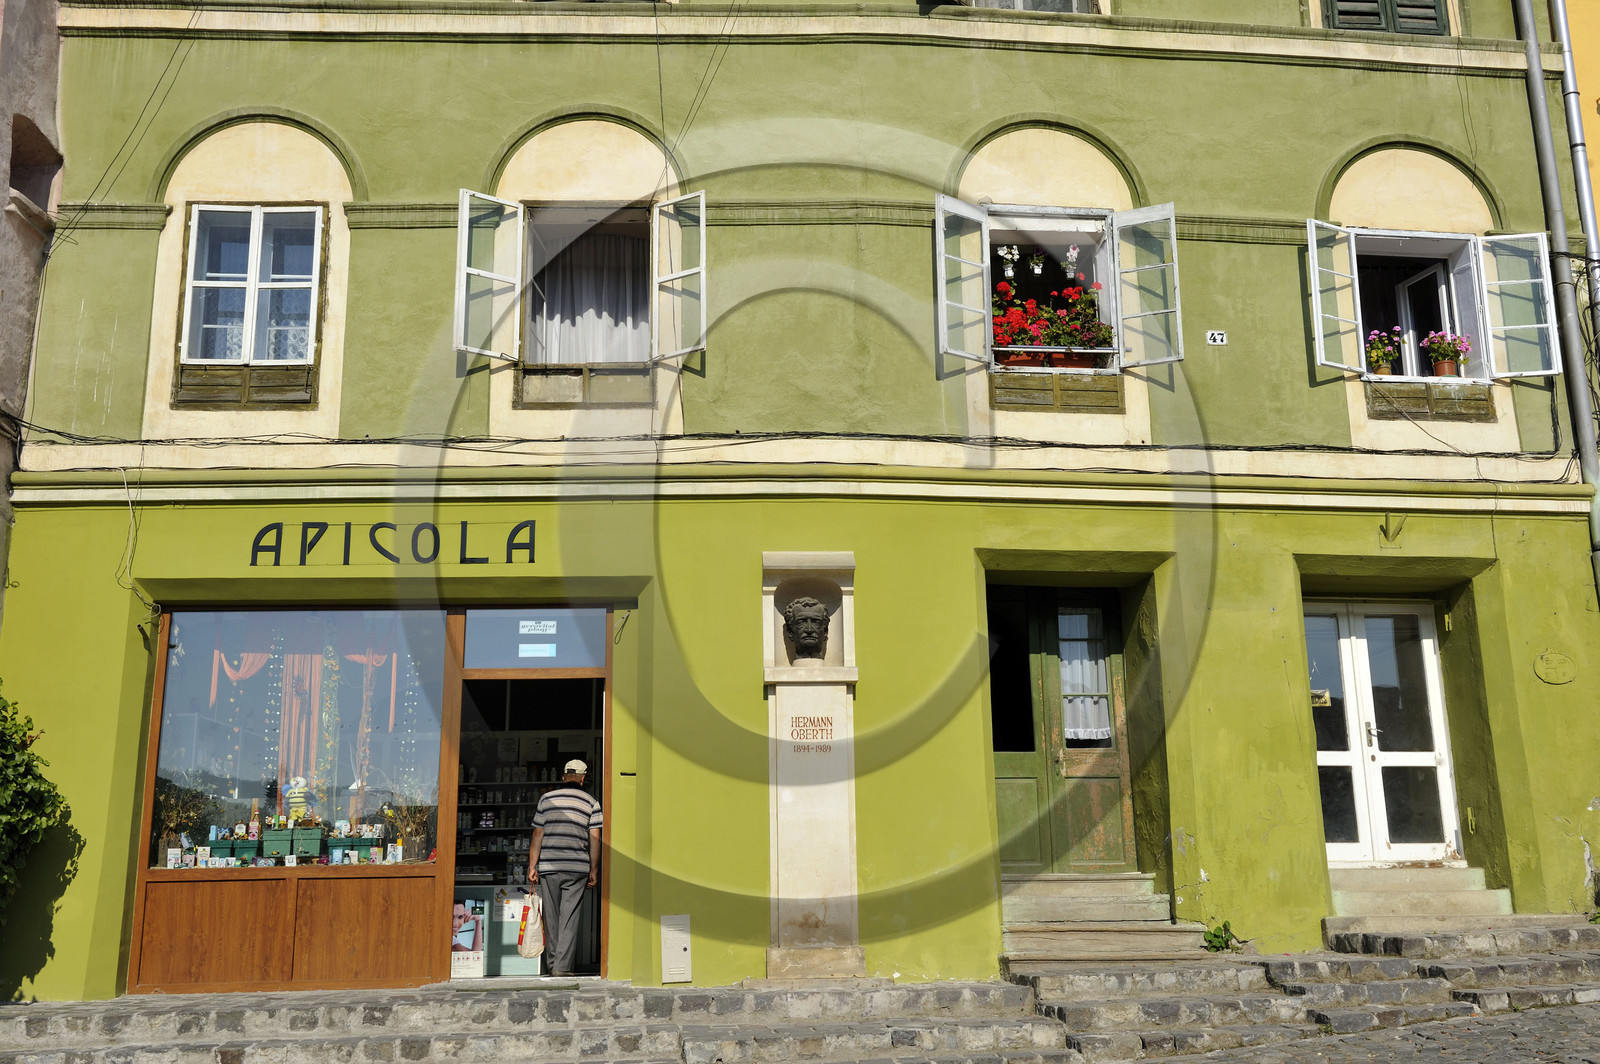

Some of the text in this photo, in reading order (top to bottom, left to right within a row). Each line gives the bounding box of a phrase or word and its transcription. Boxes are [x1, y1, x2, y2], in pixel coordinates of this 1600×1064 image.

[1209, 332, 1224, 342] 47
[249, 518, 537, 567] APICOLA
[791, 716, 832, 727] HERMANN
[791, 728, 832, 739] OBERTH
[793, 744, 831, 752] 1894-1989
